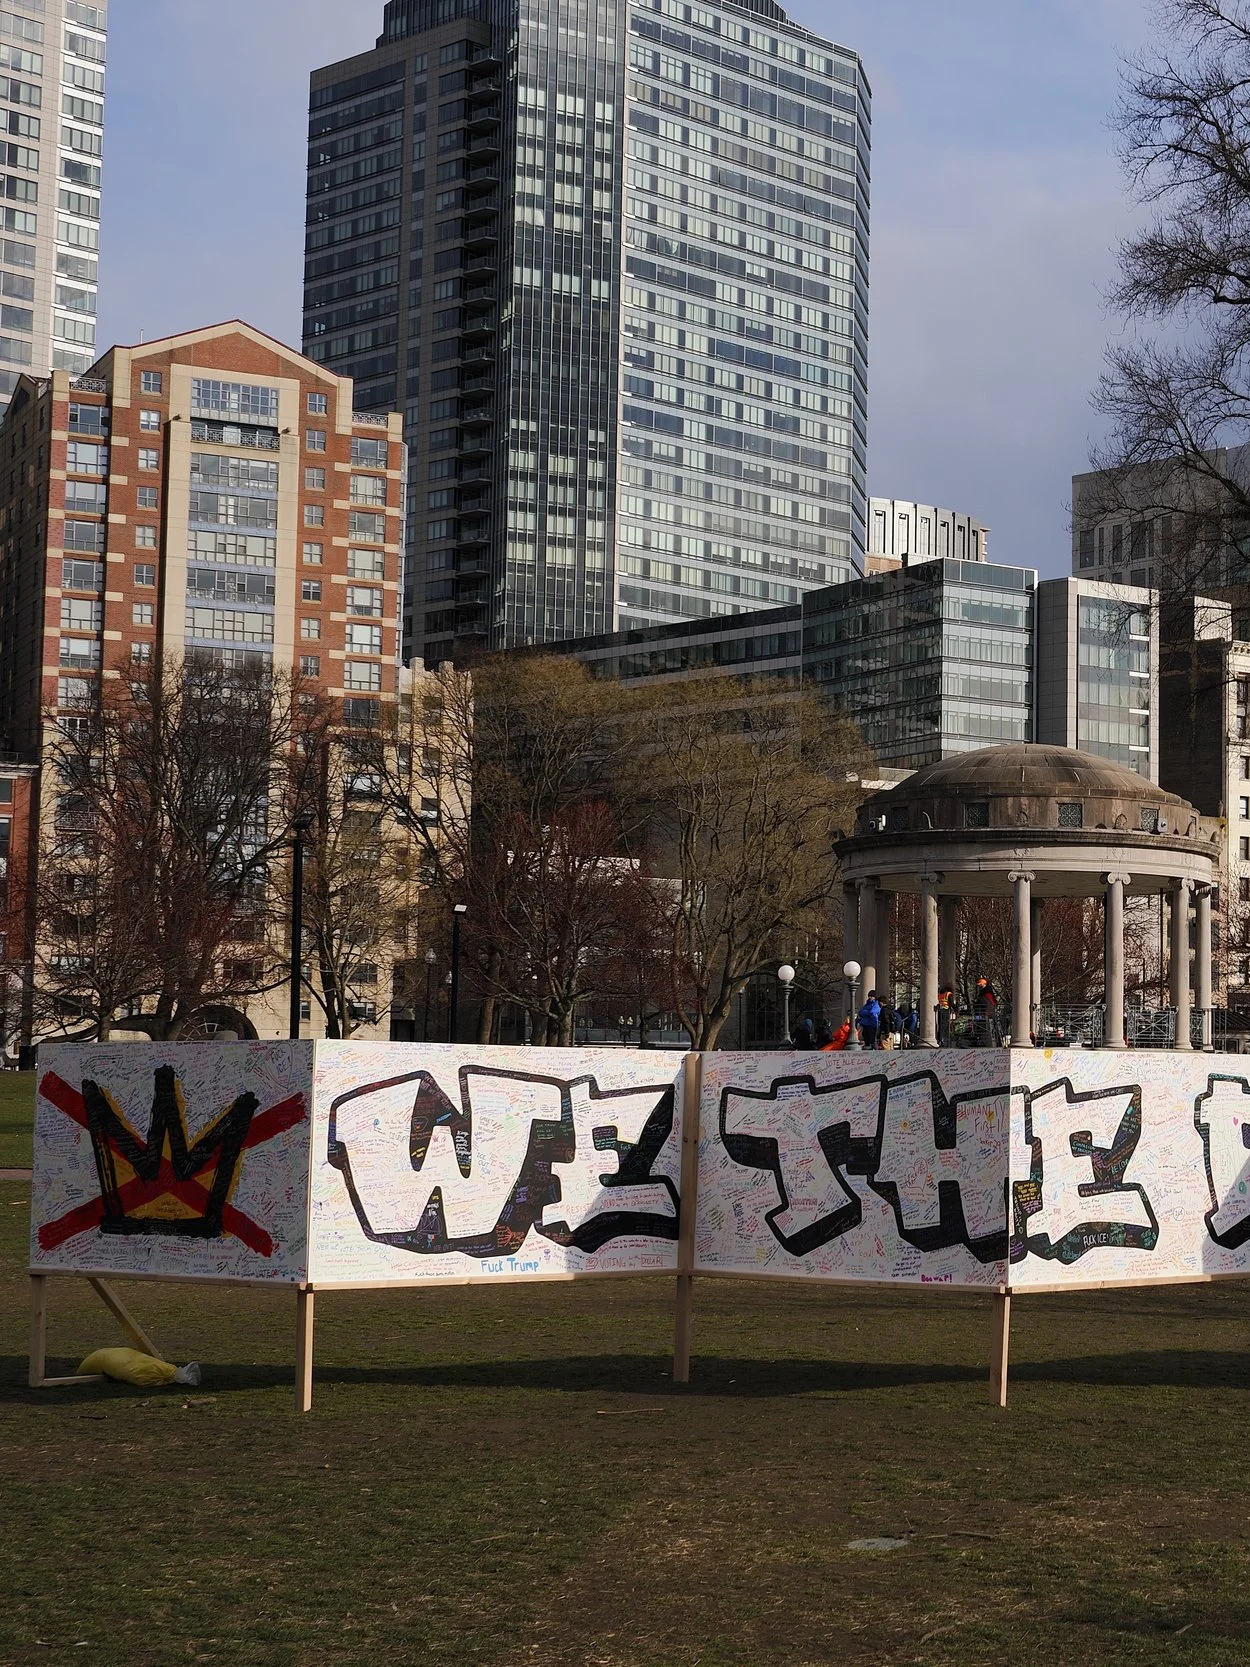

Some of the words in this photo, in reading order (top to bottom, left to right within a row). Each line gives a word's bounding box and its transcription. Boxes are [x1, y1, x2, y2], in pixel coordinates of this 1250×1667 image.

[827, 1059, 842, 1067] VOTE
[327, 1065, 680, 1257] WE
[720, 1069, 1159, 1264] THE
[1083, 1234, 1097, 1248] FUCK
[1097, 1233, 1110, 1243] ICE!
[481, 1259, 504, 1273] Fuck
